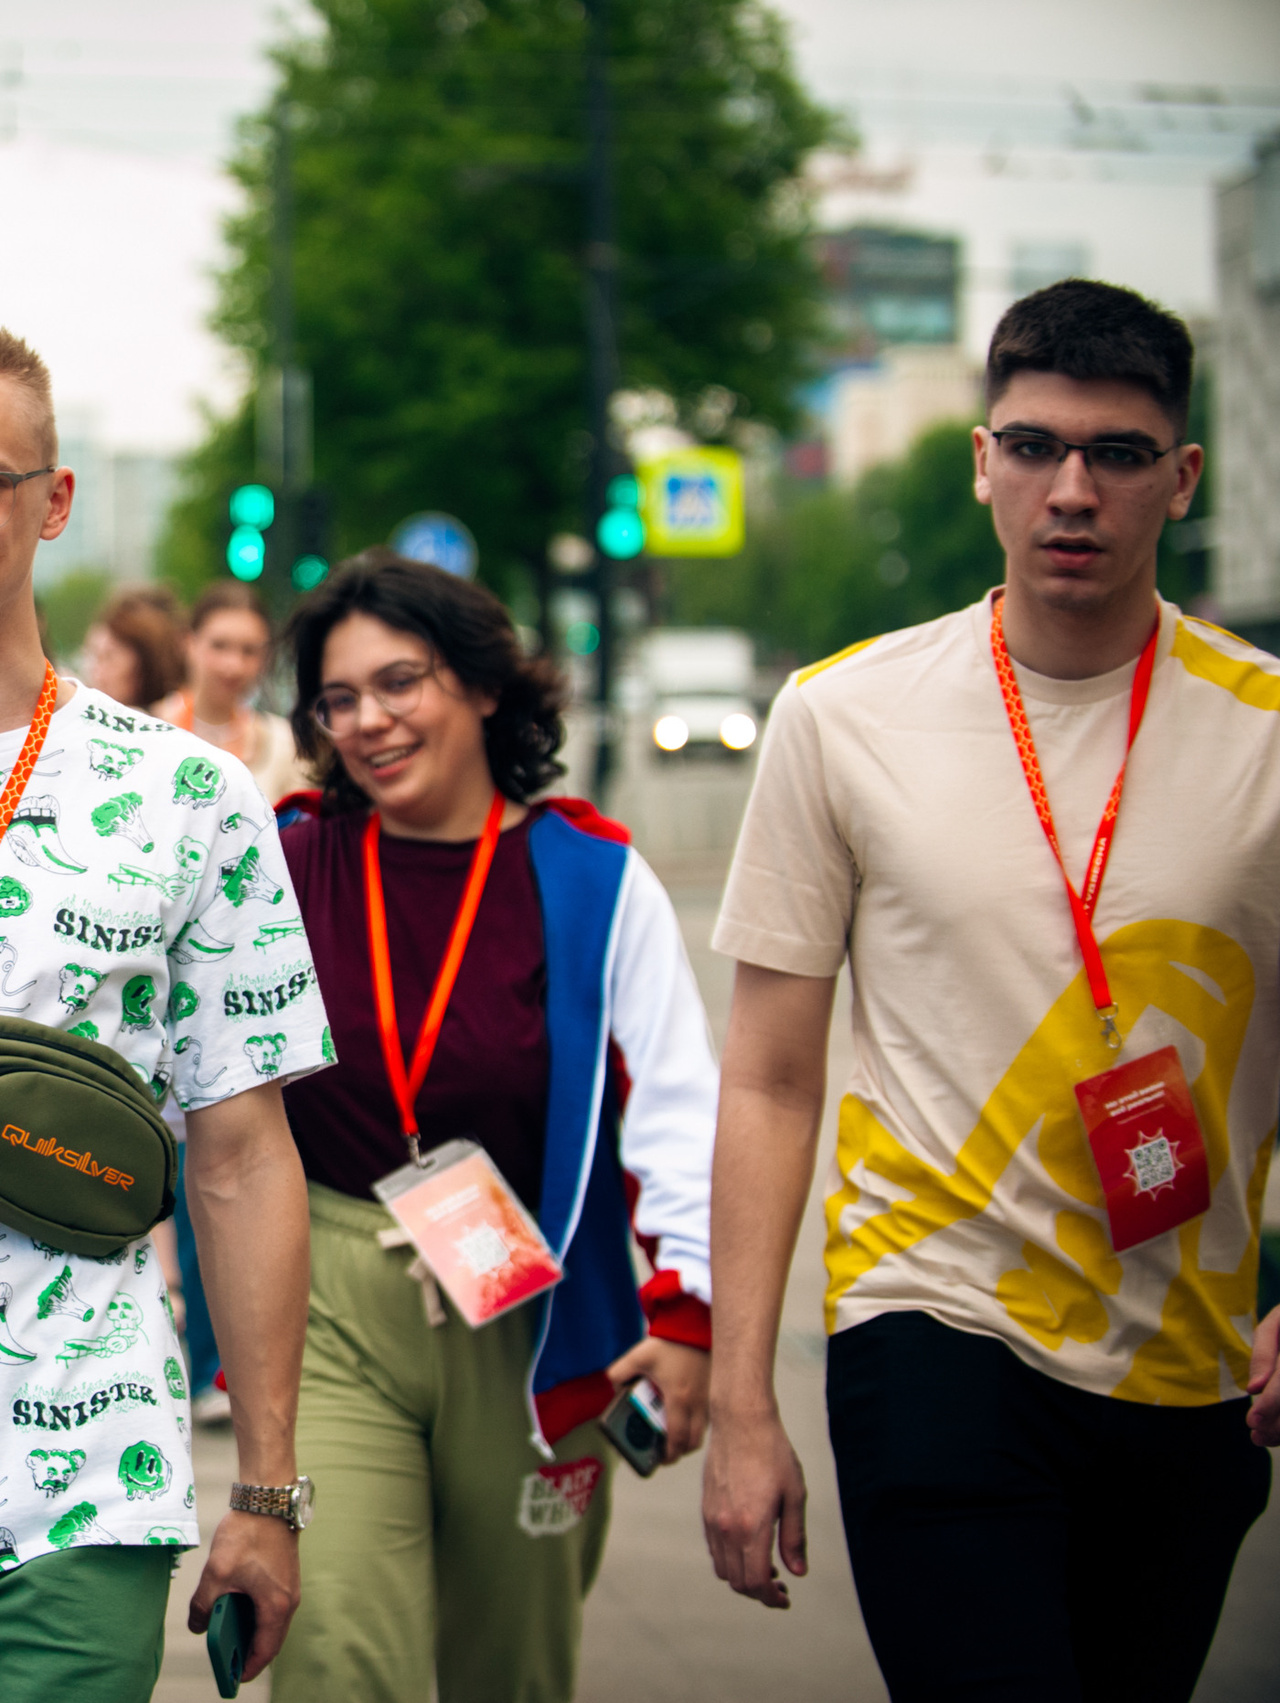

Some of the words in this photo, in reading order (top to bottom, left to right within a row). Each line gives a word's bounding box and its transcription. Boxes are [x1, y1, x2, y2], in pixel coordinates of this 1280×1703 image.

[54, 908, 164, 952] SINIST
[224, 965, 316, 1016] SINIST
[12, 1382, 157, 1431] SINISTER
